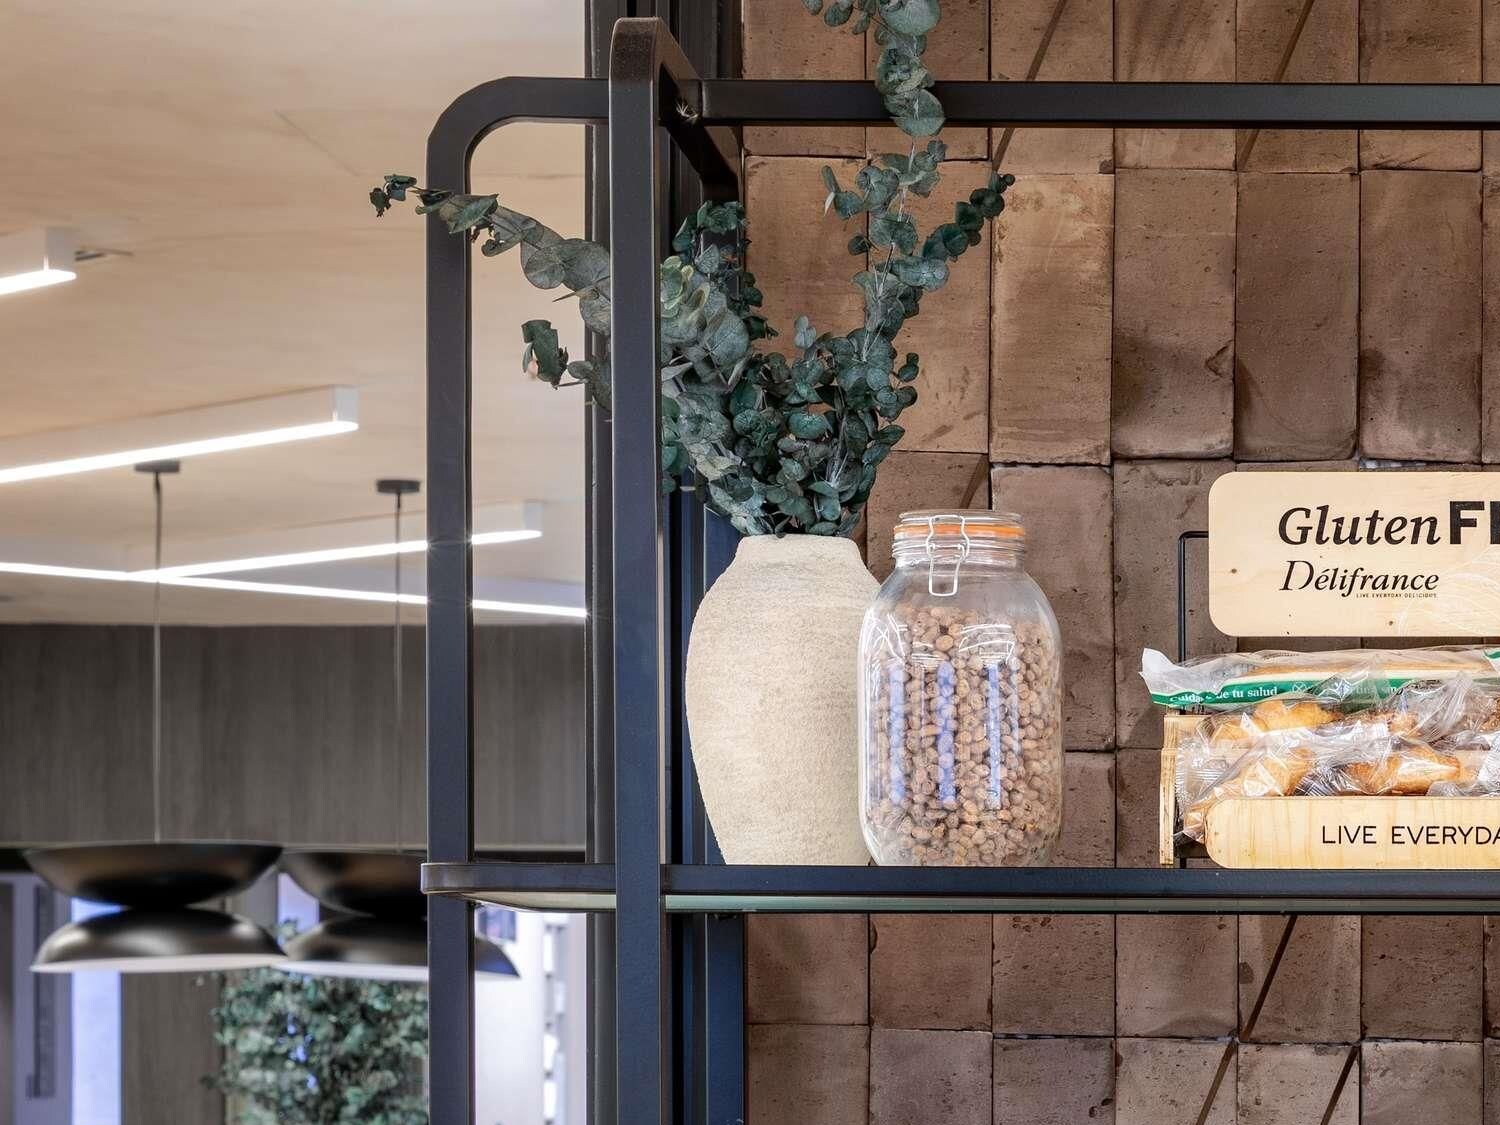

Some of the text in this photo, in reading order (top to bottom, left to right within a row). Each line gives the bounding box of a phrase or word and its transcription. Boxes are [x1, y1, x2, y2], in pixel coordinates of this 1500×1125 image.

[1278, 504, 1442, 546] Gluten
[1279, 560, 1439, 597] Délifrance
[1232, 687, 1245, 699] tu
[1247, 686, 1278, 698] salud
[1322, 825, 1377, 845] LIVE
